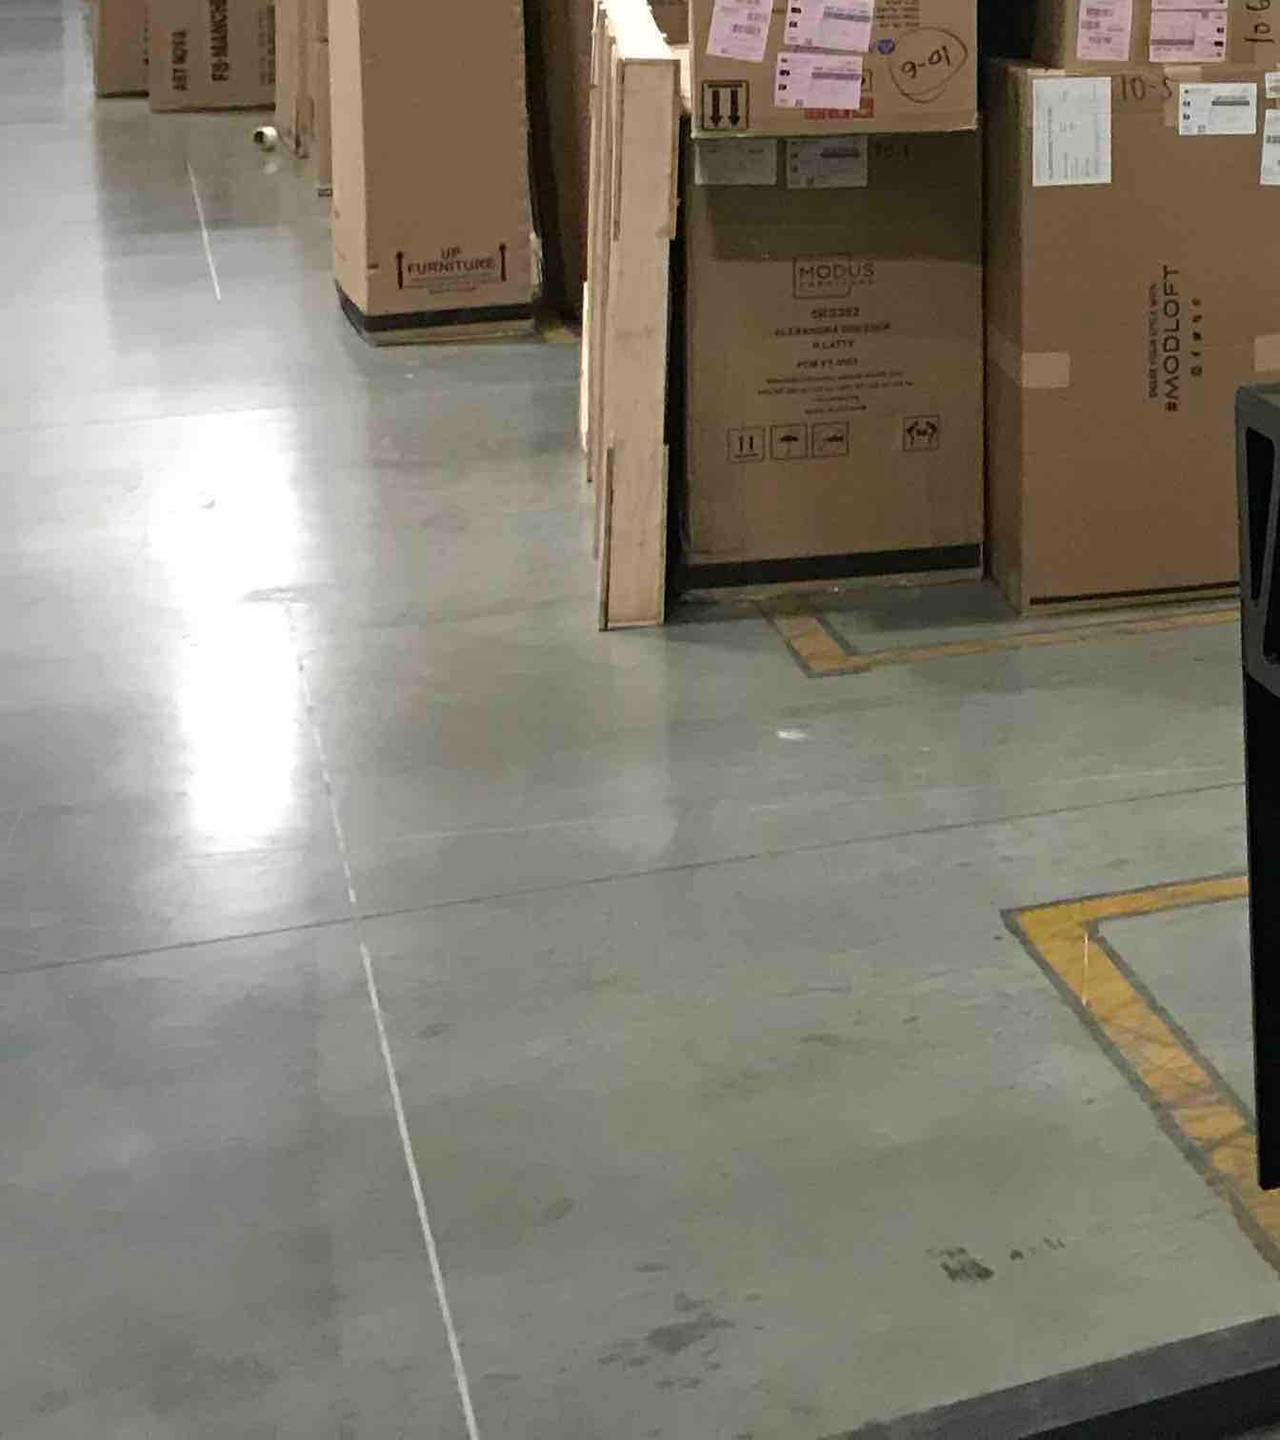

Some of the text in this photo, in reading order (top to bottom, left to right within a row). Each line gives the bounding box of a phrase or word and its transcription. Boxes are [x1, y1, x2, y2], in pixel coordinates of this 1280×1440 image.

[407, 258, 497, 276] FURNITURE
[799, 262, 875, 280] MODUS
[1162, 264, 1180, 412] #MODLOFT
